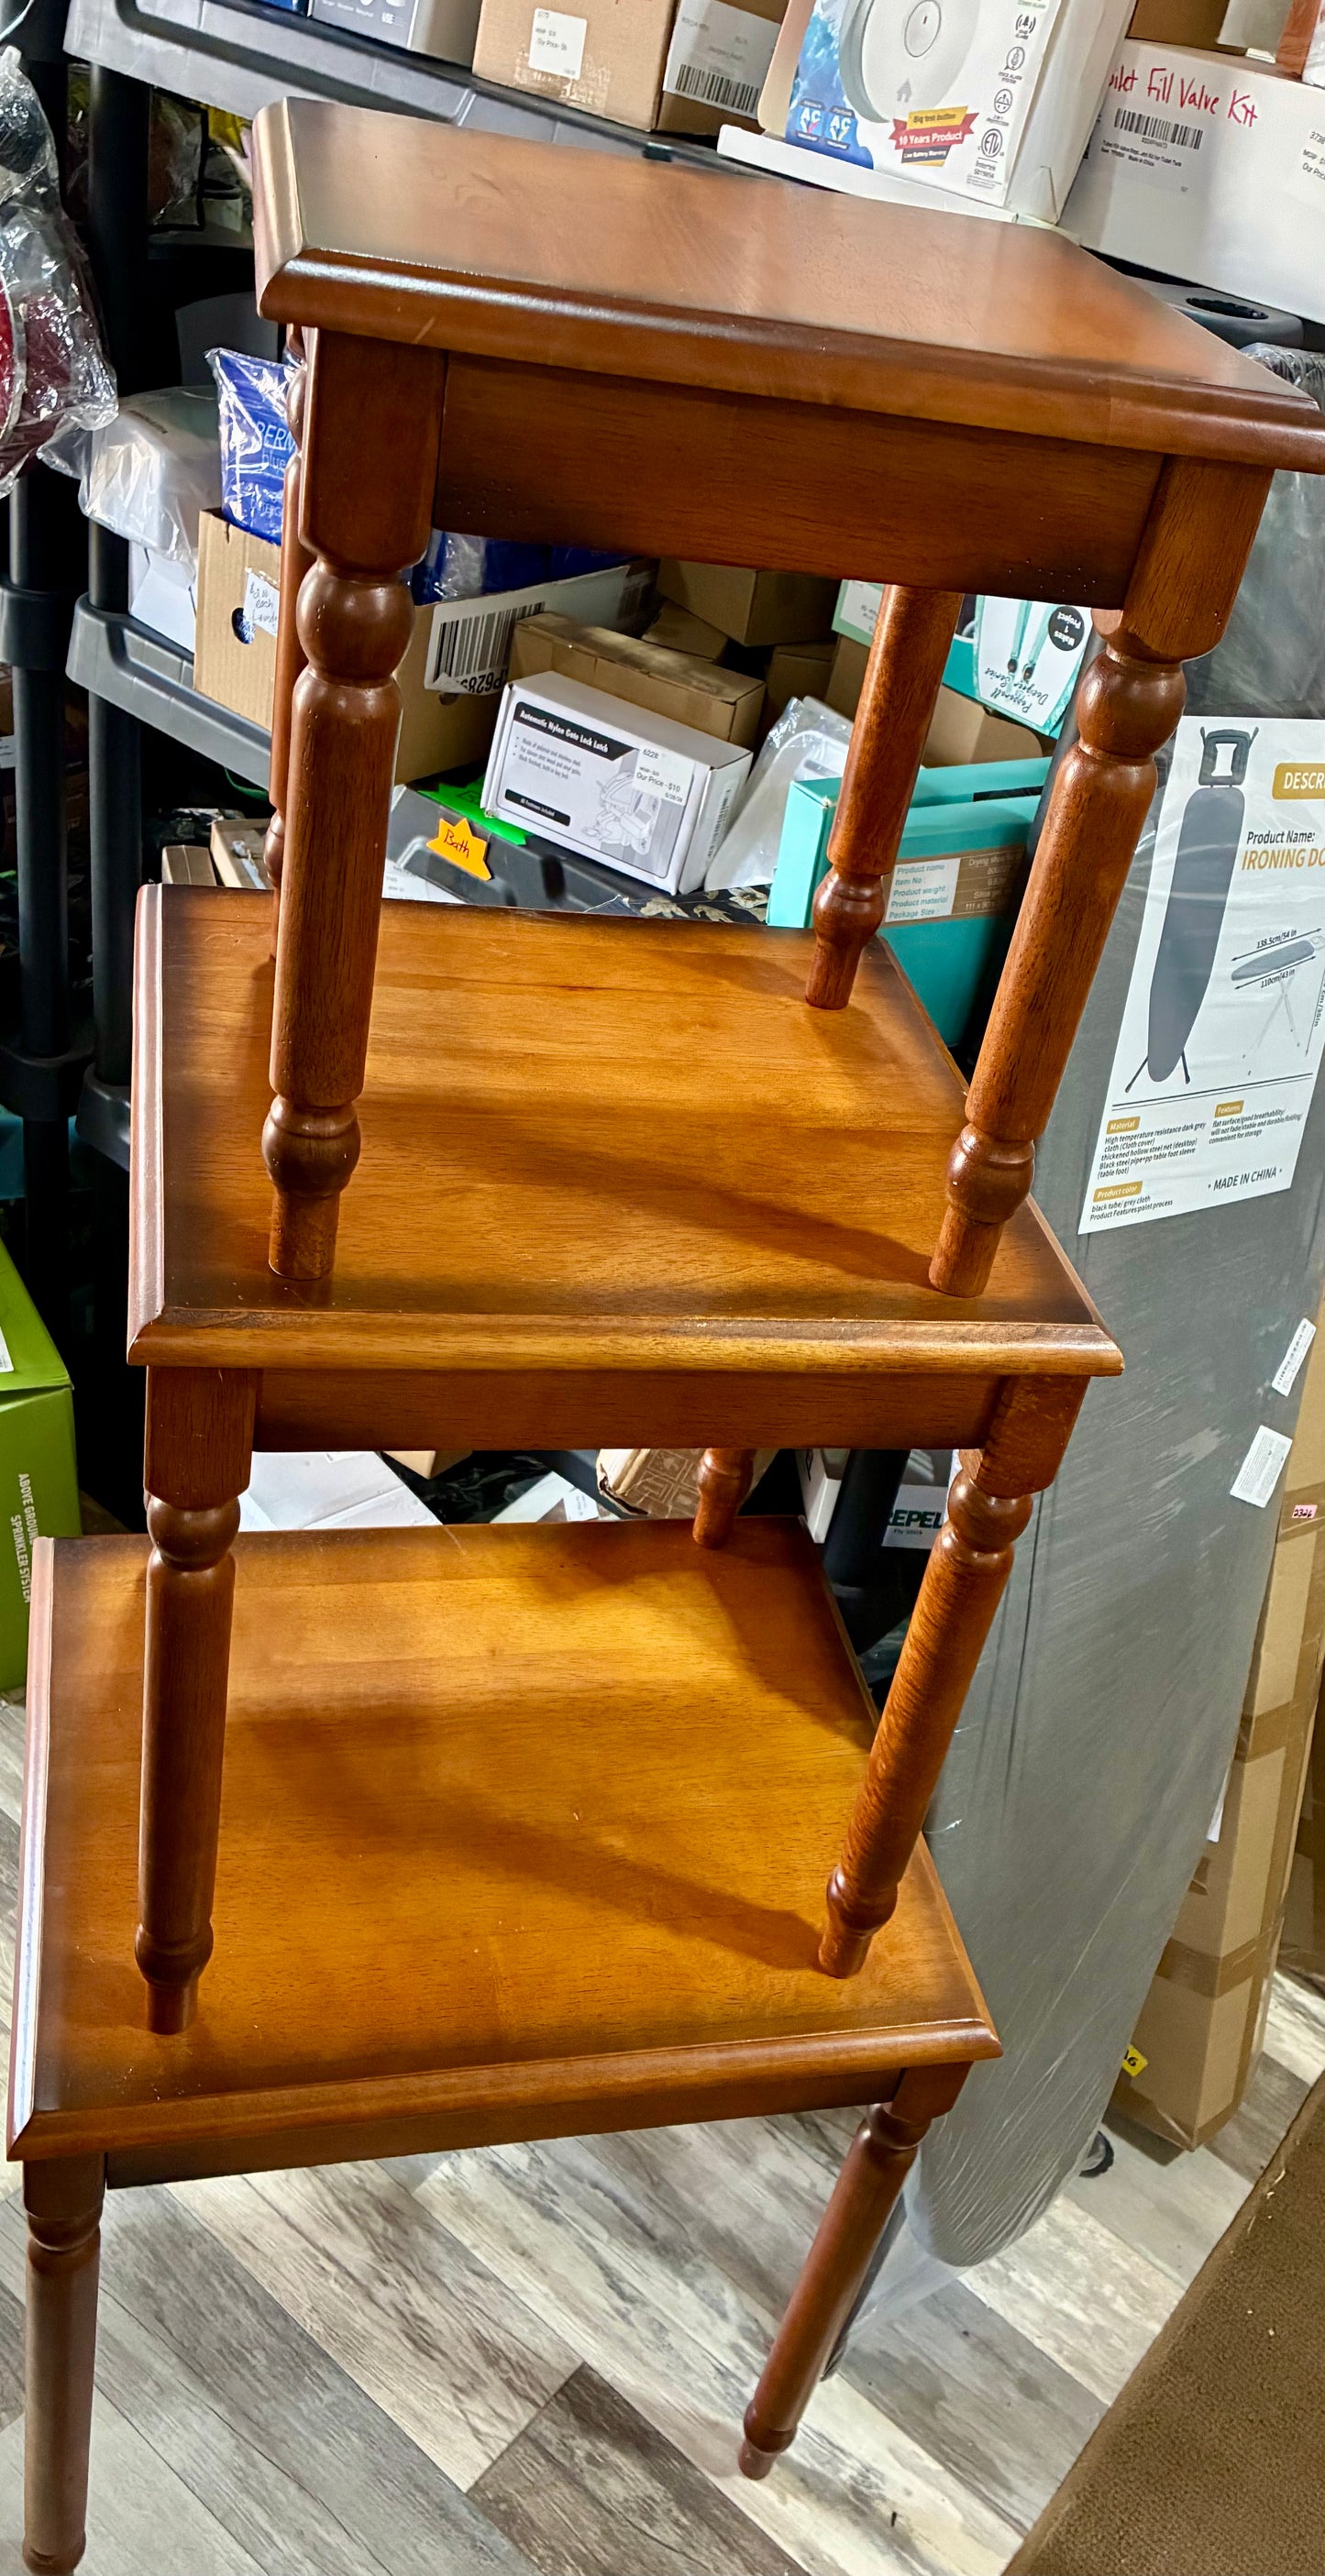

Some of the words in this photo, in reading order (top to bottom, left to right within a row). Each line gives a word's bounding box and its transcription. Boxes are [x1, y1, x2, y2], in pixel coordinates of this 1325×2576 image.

[1147, 67, 1175, 104] Fill
[1180, 78, 1220, 116] Valve
[1226, 90, 1259, 127] Kit
[913, 114, 924, 124] Big
[899, 136, 909, 147] 10
[909, 133, 931, 147] Years
[931, 130, 963, 144] Product
[1056, 611, 1083, 632] Project
[1053, 629, 1077, 648] Makes
[983, 666, 1012, 689] Series
[1011, 681, 1050, 706] Designer
[519, 710, 547, 729] Automatic
[548, 721, 565, 734] Nylon
[565, 729, 580, 741] Gate
[580, 734, 592, 746] Lock
[592, 740, 609, 754] Latch
[636, 772, 647, 782] Our
[648, 775, 664, 787] Price
[668, 782, 681, 793] $10
[444, 829, 469, 859] Bath
[1246, 831, 1284, 844] Product
[1286, 829, 1316, 844] Name:
[1242, 848, 1307, 870] IRONING
[897, 865, 925, 875] Product
[926, 864, 945, 872] name
[893, 887, 922, 897] Product
[922, 886, 946, 896] weight
[891, 899, 920, 908] Product
[921, 896, 949, 906] material
[889, 910, 918, 919] Package
[1217, 1106, 1242, 1115] Features
[1104, 1135, 1119, 1145] High
[1119, 1128, 1154, 1143] temperature
[1154, 1126, 1182, 1138] resistance
[1182, 1122, 1193, 1132] dark
[1194, 1121, 1207, 1131] grey
[1110, 1120, 1136, 1131] Material
[1210, 1128, 1220, 1137] will
[1104, 1143, 1120, 1153] cloth
[1120, 1139, 1137, 1151] (Cloth
[1137, 1137, 1155, 1147] cover)
[1209, 1134, 1237, 1145] convenient
[1244, 1128, 1263, 1139] storage
[1099, 1161, 1115, 1171] Black
[1115, 1157, 1130, 1167] steel
[1130, 1155, 1153, 1167] pipe+pp
[1153, 1152, 1167, 1161] table
[1167, 1150, 1179, 1158] foot
[1179, 1148, 1197, 1157] sleeve
[1100, 1150, 1130, 1162] thickened
[1130, 1147, 1149, 1158] hollow
[1149, 1144, 1163, 1153] steel
[1173, 1138, 1198, 1150] (desktop)
[1098, 1169, 1115, 1180] (table
[1115, 1166, 1130, 1177] foot)
[1213, 1174, 1240, 1191] MADE
[1240, 1172, 1251, 1186] IN
[1250, 1166, 1277, 1183] CHINA
[1098, 1188, 1121, 1199] Product
[1122, 1184, 1139, 1194] color
[1089, 1211, 1113, 1222] Product
[1153, 1199, 1174, 1211] process
[1091, 1203, 1108, 1213] black
[1123, 1197, 1137, 1207] grey
[1137, 1194, 1152, 1205] cloth
[18, 1473, 34, 1506] ABOVE
[10, 1514, 28, 1568] SPRINKLER
